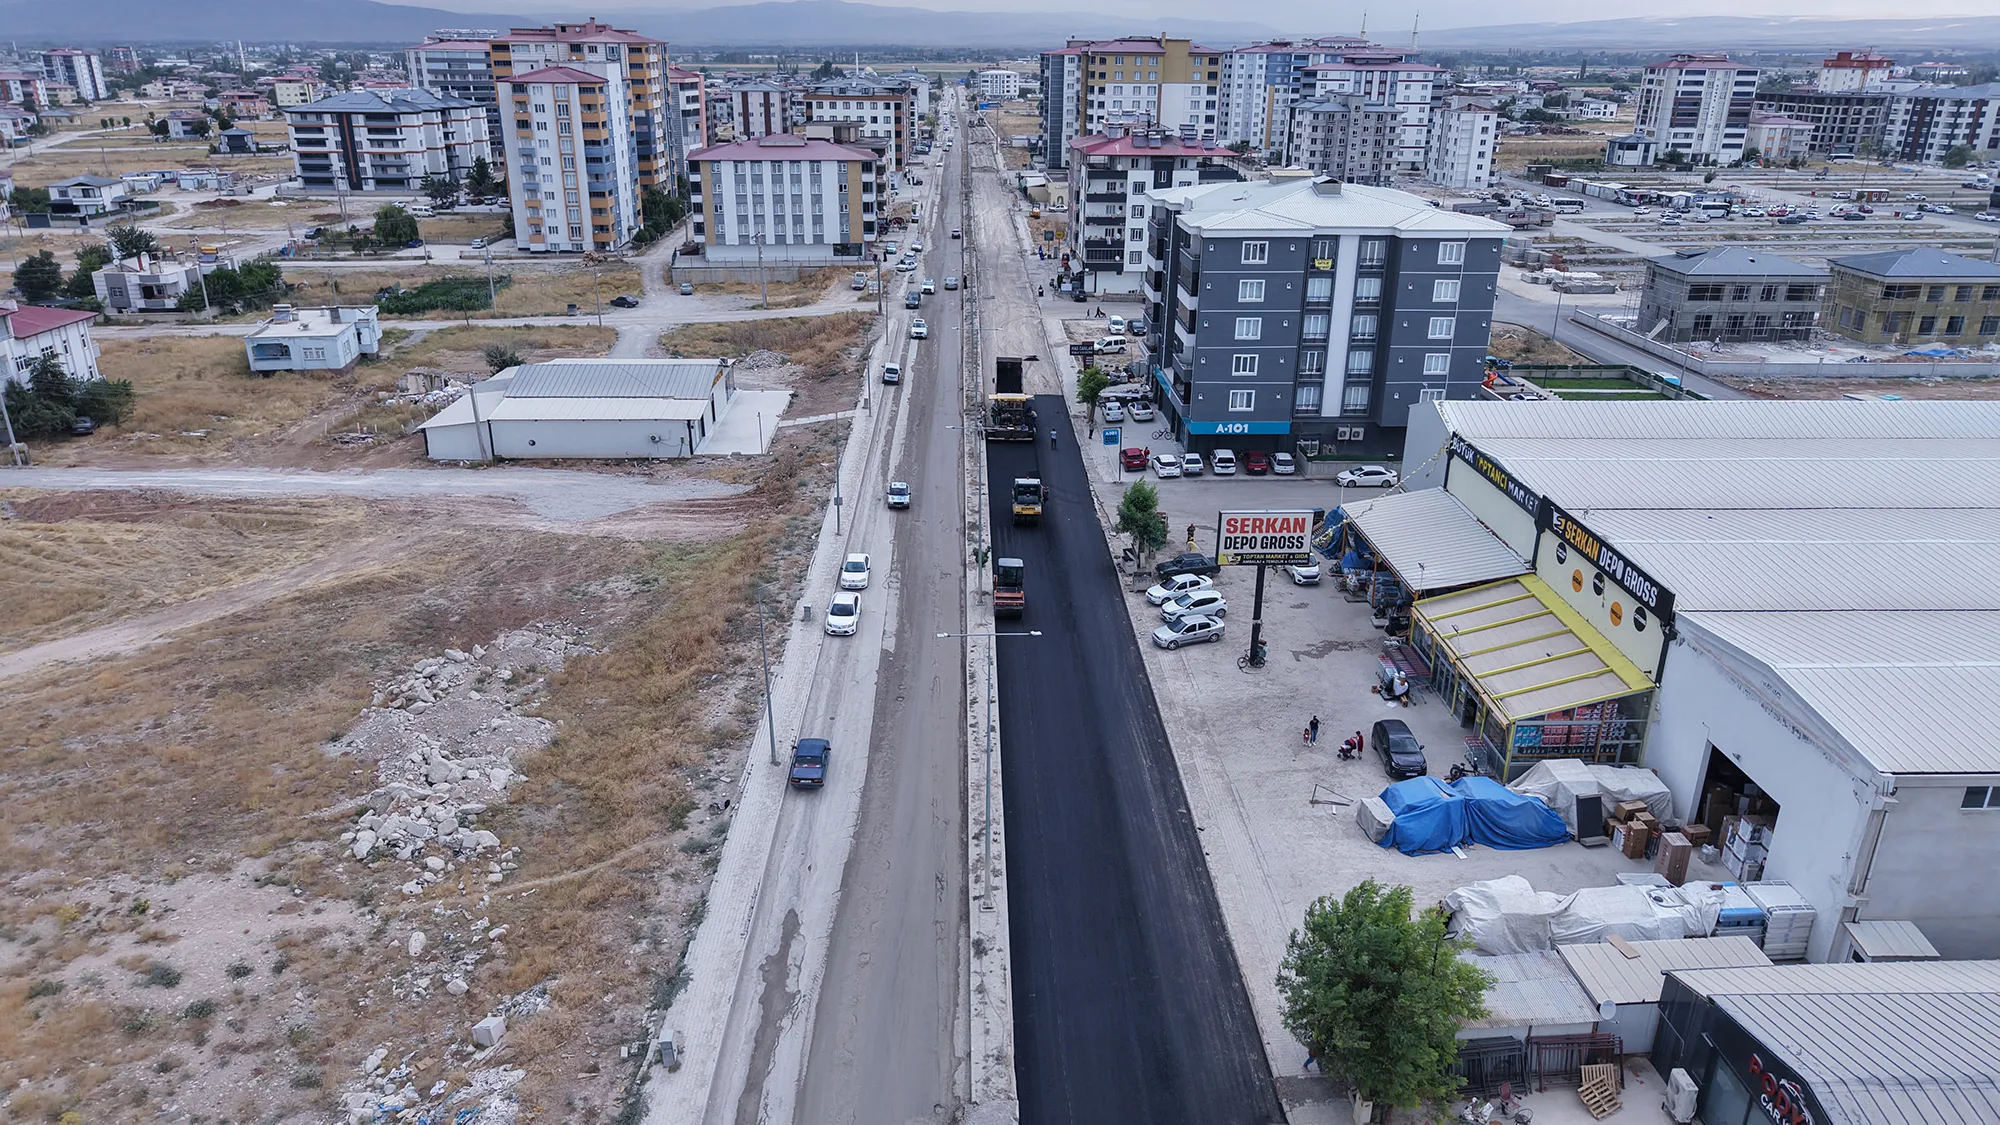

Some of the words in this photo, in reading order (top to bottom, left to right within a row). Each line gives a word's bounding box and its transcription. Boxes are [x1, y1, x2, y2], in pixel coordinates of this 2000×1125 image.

[1225, 517, 1307, 534] SERKAN
[1224, 535, 1258, 550] DEPO
[1260, 535, 1304, 550] GROSS
[1565, 521, 1600, 561] SERKAN
[1599, 546, 1625, 580] DEPO
[1624, 566, 1658, 607] GROSS
[1760, 1094, 1782, 1124] CAR
